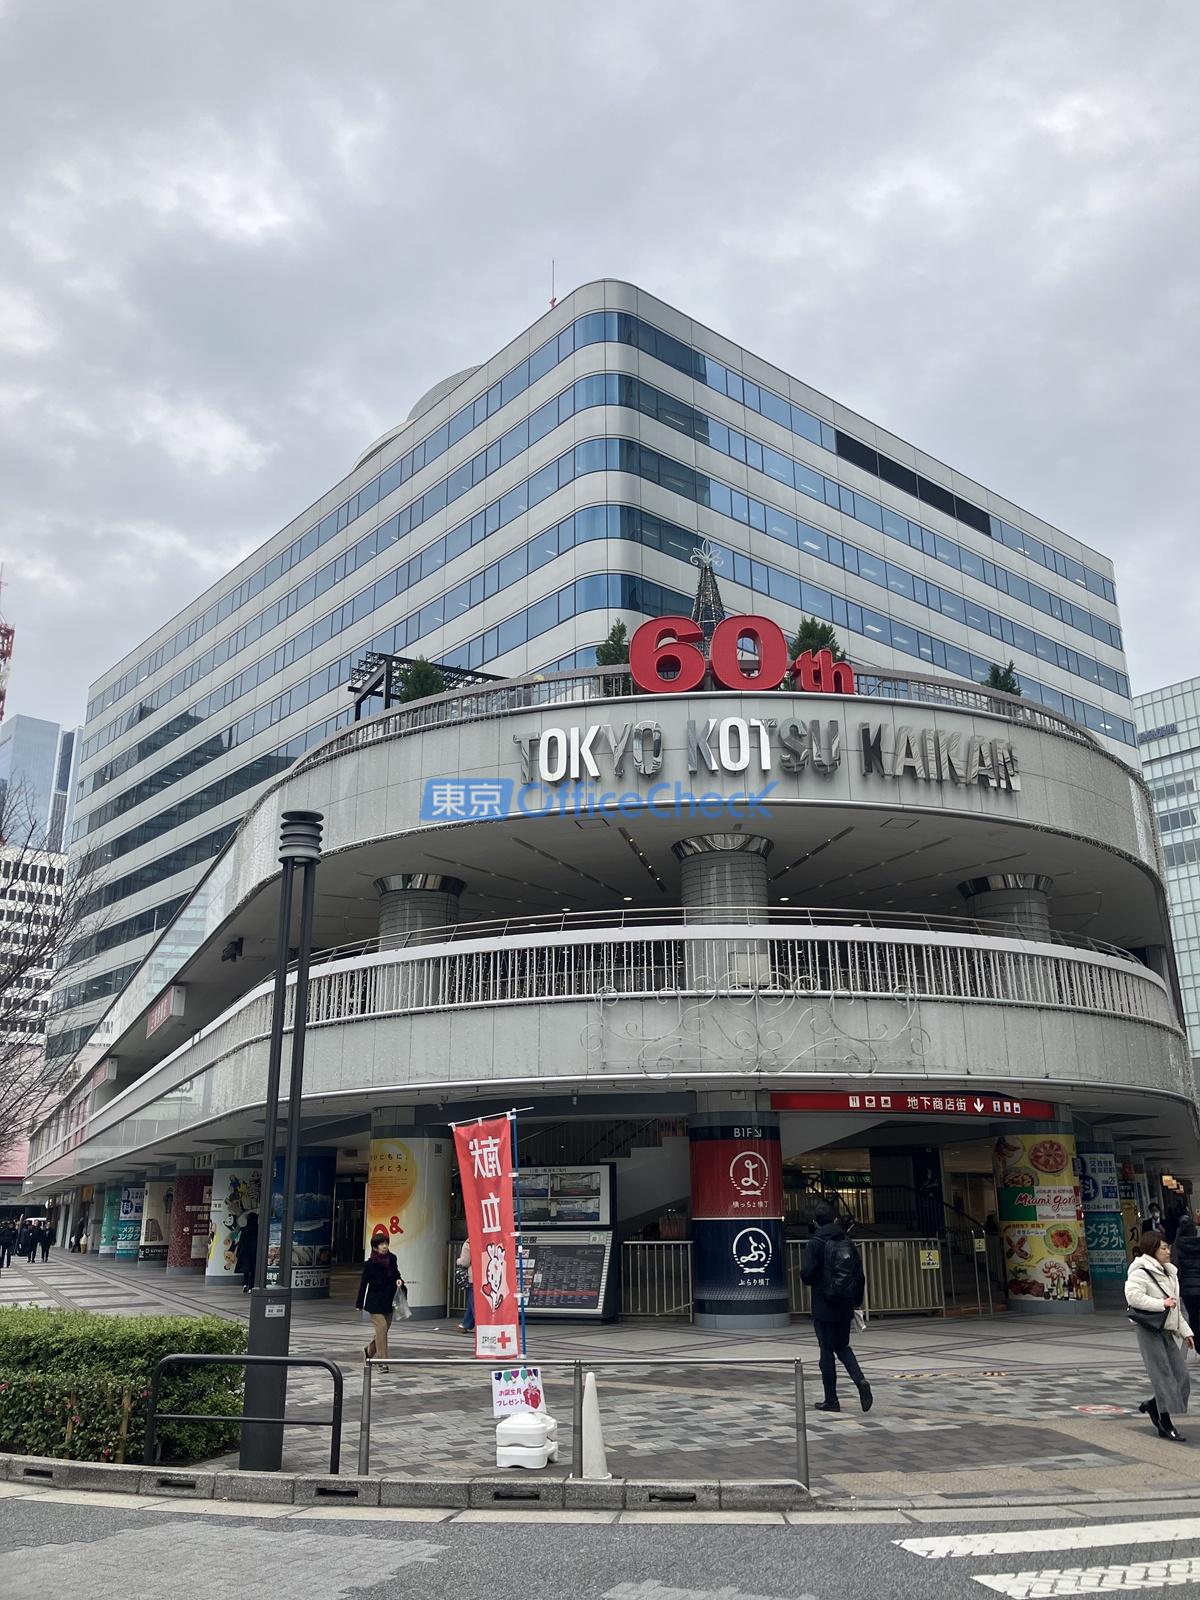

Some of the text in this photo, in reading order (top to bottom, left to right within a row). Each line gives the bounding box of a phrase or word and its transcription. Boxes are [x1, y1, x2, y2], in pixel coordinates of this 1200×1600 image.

[629, 614, 857, 695] 60th
[512, 716, 1022, 792] TOKYO KOTSU KAIKAN
[906, 1095, 967, 1112] 地下商店街
[733, 1127, 752, 1138] B1F
[1086, 1223, 1119, 1236] メガネ
